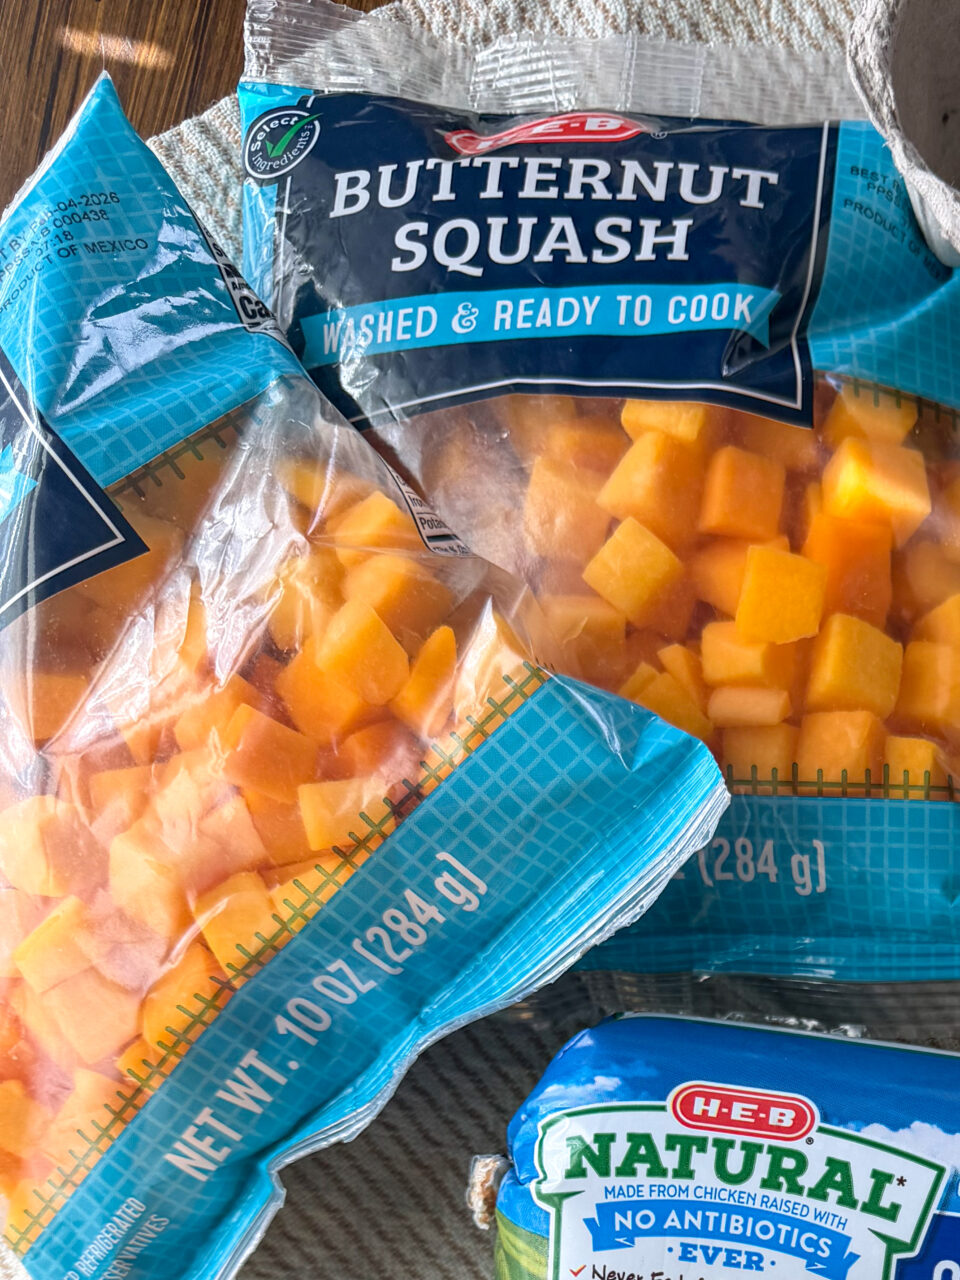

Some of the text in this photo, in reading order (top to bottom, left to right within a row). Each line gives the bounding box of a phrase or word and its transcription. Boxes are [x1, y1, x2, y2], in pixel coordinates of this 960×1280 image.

[251, 116, 299, 151] Select
[329, 157, 779, 219] BUTTERNUT
[850, 166, 889, 184] BEST
[53, 209, 110, 229] 000438
[843, 198, 907, 243] PRODUCT
[57, 244, 80, 259] OF
[84, 238, 149, 254] MEXICO
[391, 217, 694, 277] SQUASH
[323, 292, 755, 355] WASHED & READY TO COOK
[791, 840, 827, 896] g)
[163, 852, 488, 1182] NET WT. 10 OZ (284 g)
[693, 1096, 797, 1128] H-E-B
[604, 1184, 848, 1231] MADE FROM CHICKEN RAISED WITH
[74, 1197, 147, 1277] REFRIGERATED
[614, 1209, 833, 1258] NO ANTIBIOTICS
[678, 1242, 764, 1272] EVER
